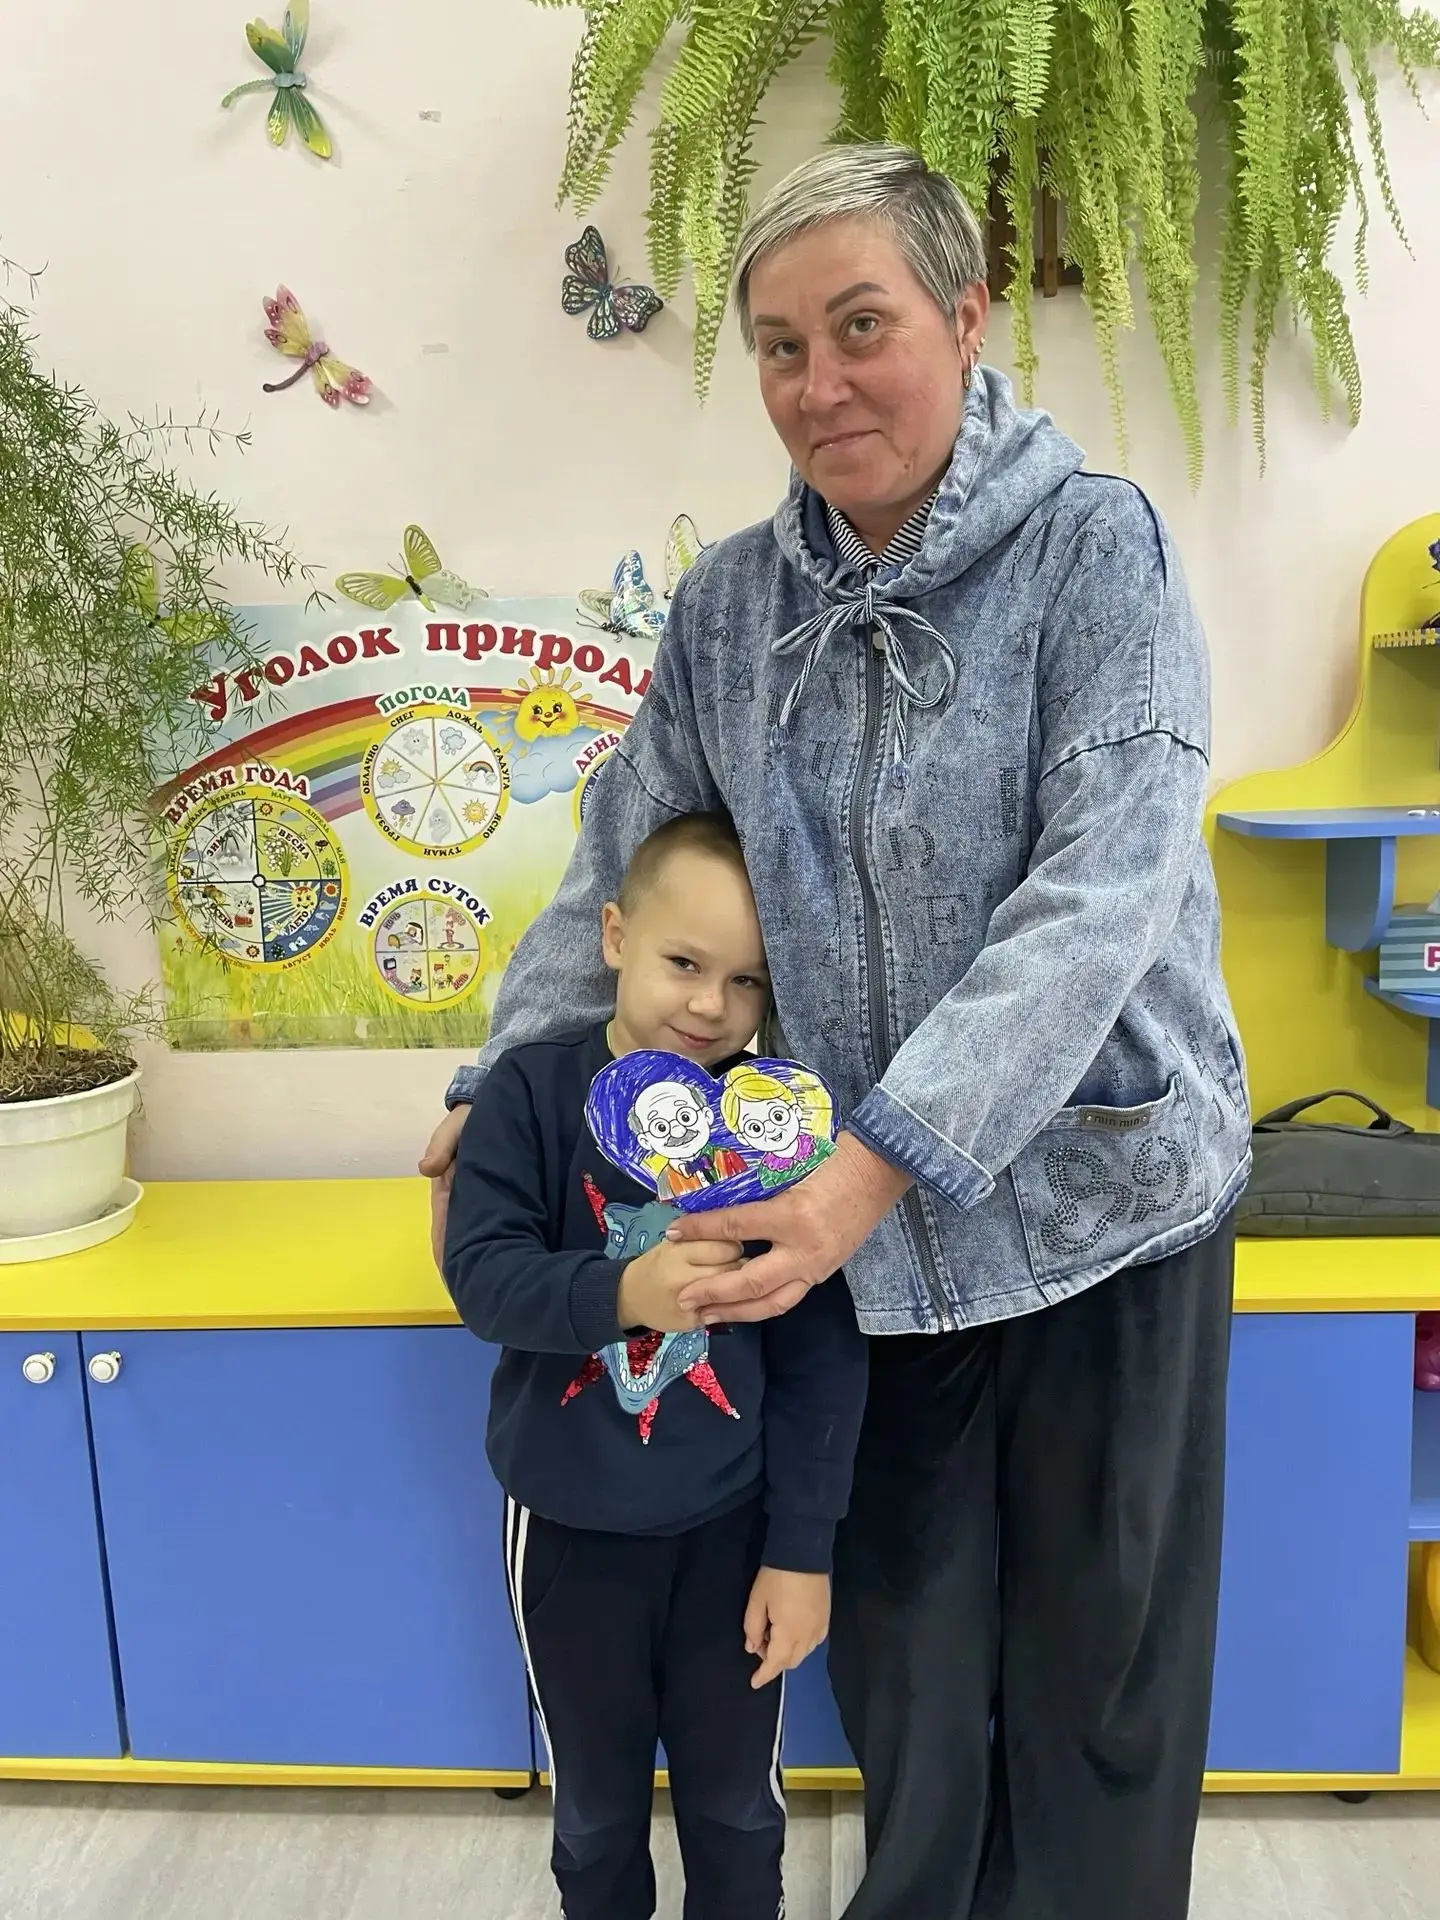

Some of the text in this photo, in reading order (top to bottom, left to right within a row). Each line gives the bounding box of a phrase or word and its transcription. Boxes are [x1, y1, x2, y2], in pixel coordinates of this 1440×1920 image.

[190, 627, 400, 720] Уголок
[379, 685, 468, 713] ПОГОДА
[390, 710, 415, 728] СНЕГ
[447, 710, 483, 734] ДОЖДЬ
[575, 733, 620, 774] ДЕНЬ
[363, 744, 379, 794] ОБЛАЧНО
[493, 747, 510, 790] РАДУГА
[166, 766, 308, 825] ВРЕМЯ ГОДА
[271, 792, 293, 803] МАРТ
[305, 808, 330, 834] АПРЕЛЬ
[375, 812, 401, 842] ГРОЗА
[483, 813, 502, 839] ЯСНО
[206, 834, 226, 857] ЗИМ
[277, 828, 311, 860] ВЕСНА
[335, 846, 346, 864] МАЙ
[424, 846, 461, 857] ТУМАН
[337, 897, 348, 921] ИЮНЬ
[360, 878, 490, 927] ВРЕМЯ СУТОК
[287, 911, 310, 935] ЛЕТО
[319, 927, 337, 949] ИЮЛЬ
[282, 955, 312, 970] АВГУСТ
